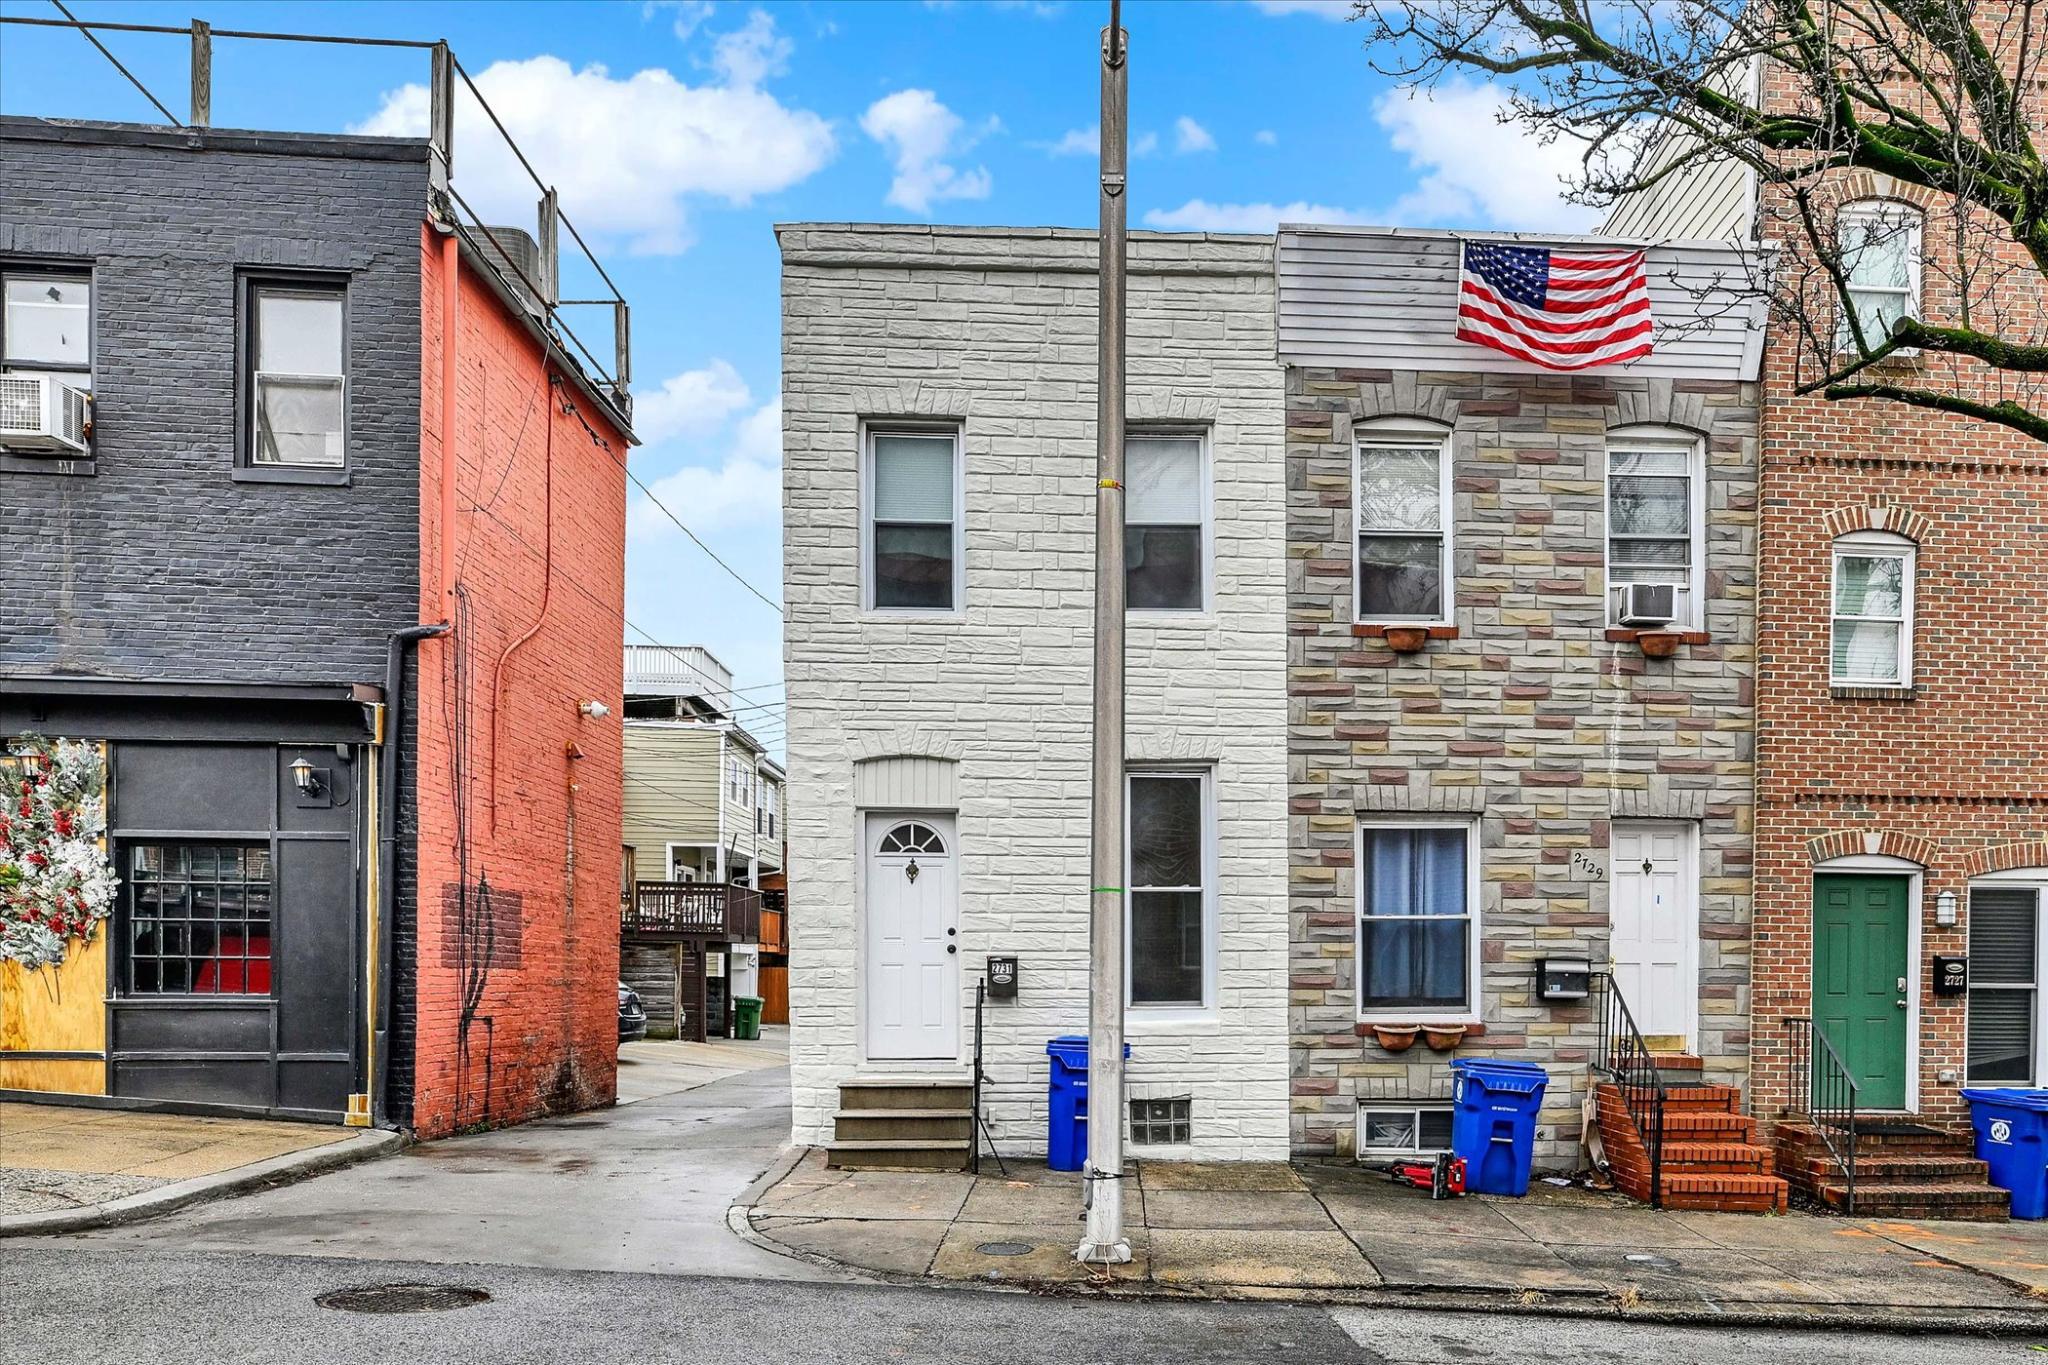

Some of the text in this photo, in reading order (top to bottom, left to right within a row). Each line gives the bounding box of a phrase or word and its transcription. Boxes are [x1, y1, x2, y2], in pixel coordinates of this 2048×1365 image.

[1574, 852, 1603, 879] 2729
[992, 963, 1011, 973] 2731
[1944, 975, 1964, 986] 2727
